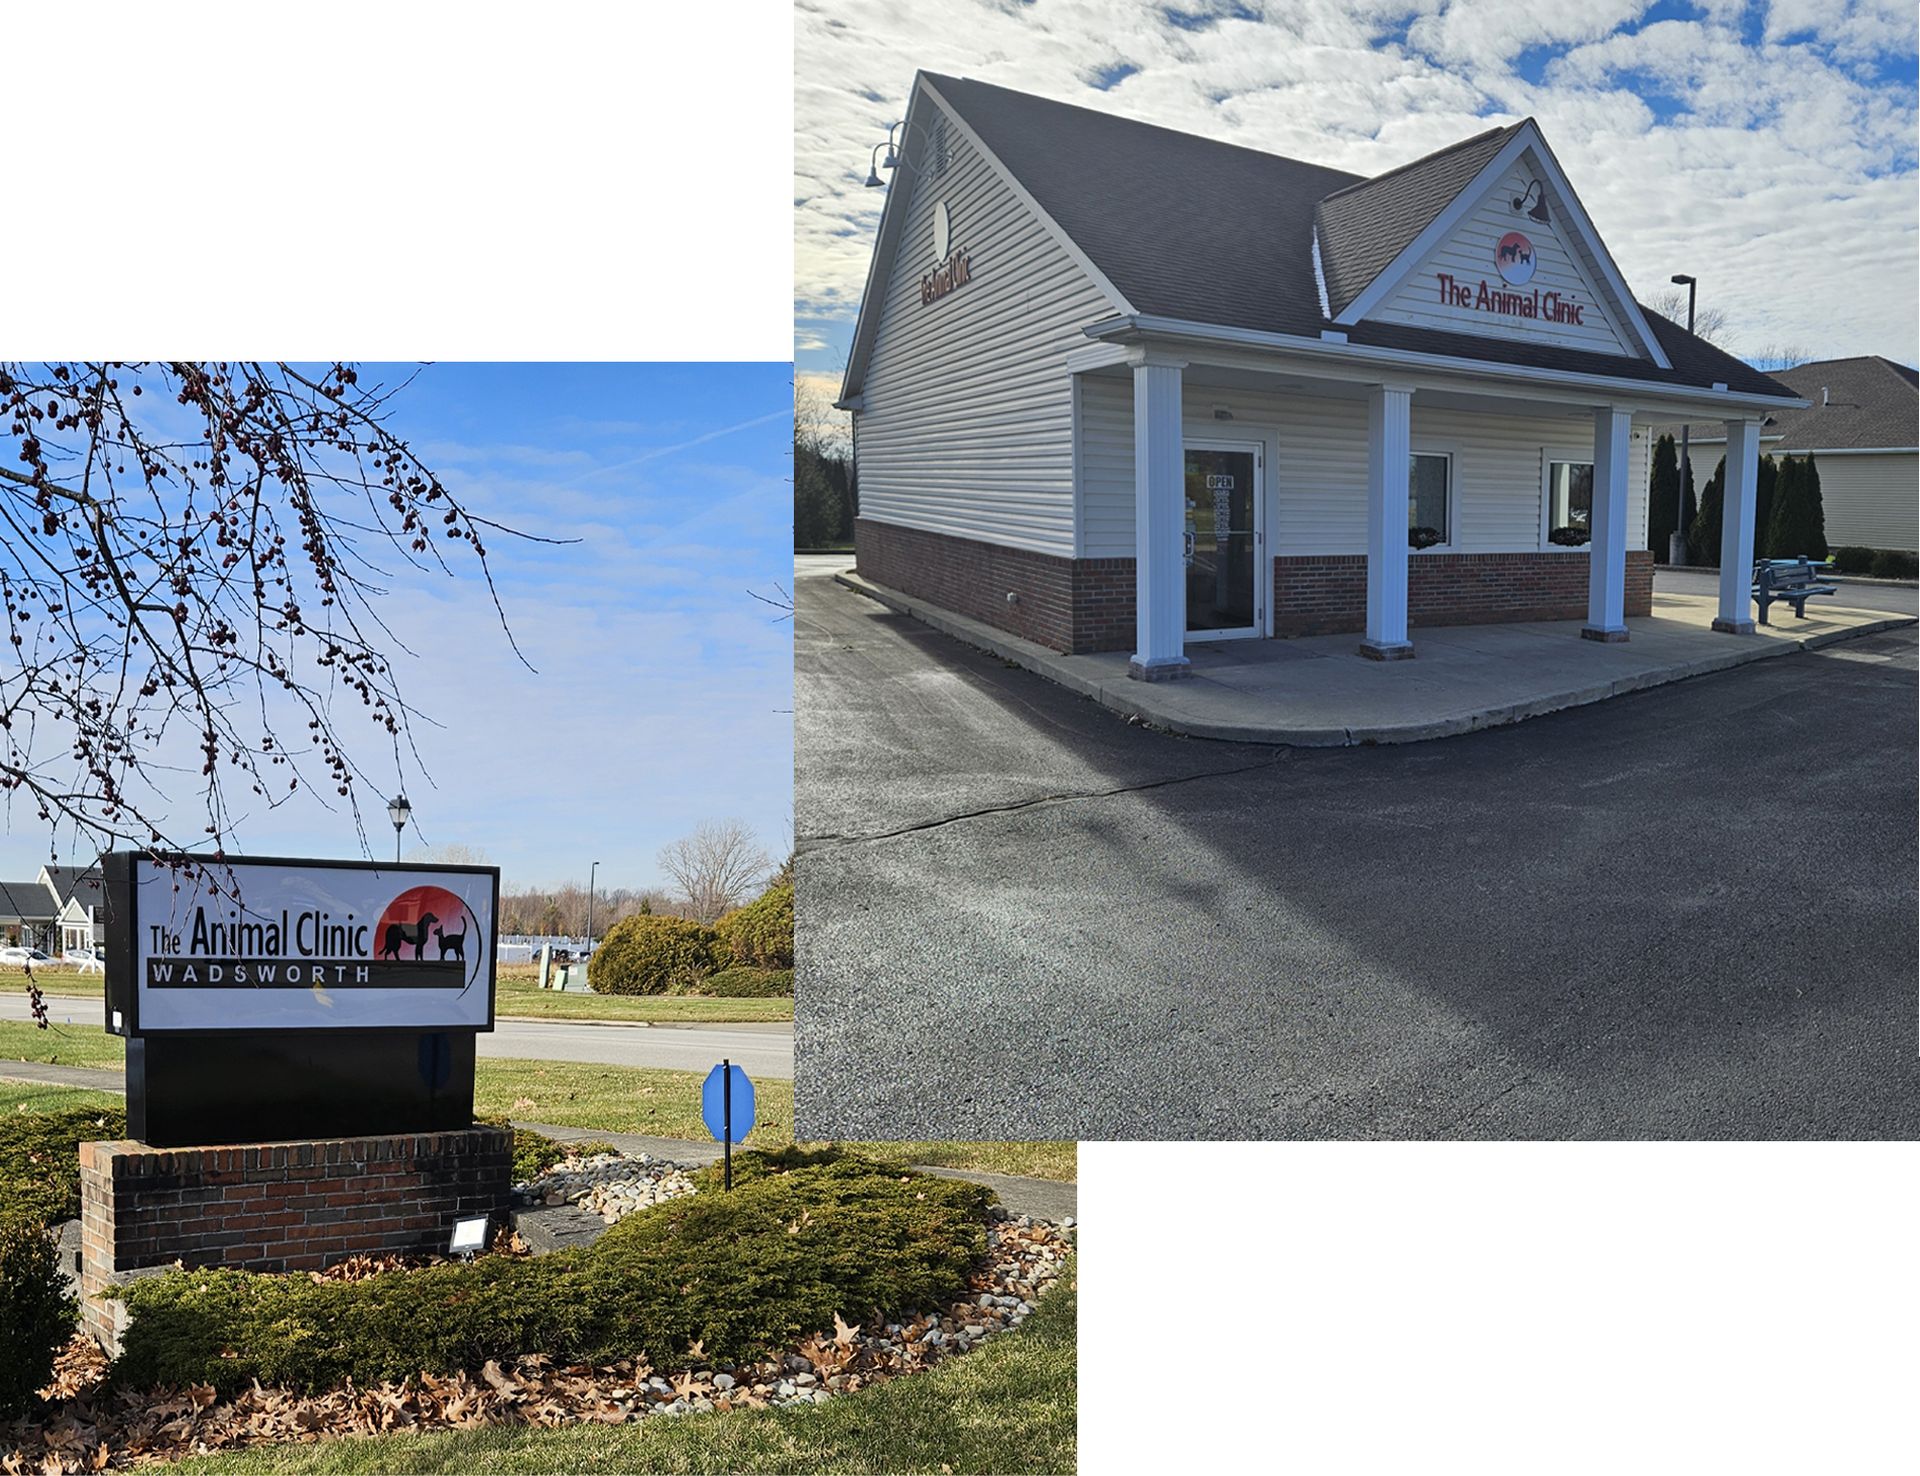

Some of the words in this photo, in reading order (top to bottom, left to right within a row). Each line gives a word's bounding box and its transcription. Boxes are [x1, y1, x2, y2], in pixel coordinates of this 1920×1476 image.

[1437, 273, 1472, 308] The
[1475, 280, 1538, 319] Animal
[1543, 291, 1584, 325] Clinic
[1208, 476, 1232, 487] OPEN
[150, 925, 181, 955] The
[190, 906, 288, 957] Animal
[296, 912, 368, 957] Clinic
[153, 964, 369, 982] WADSWORTH
